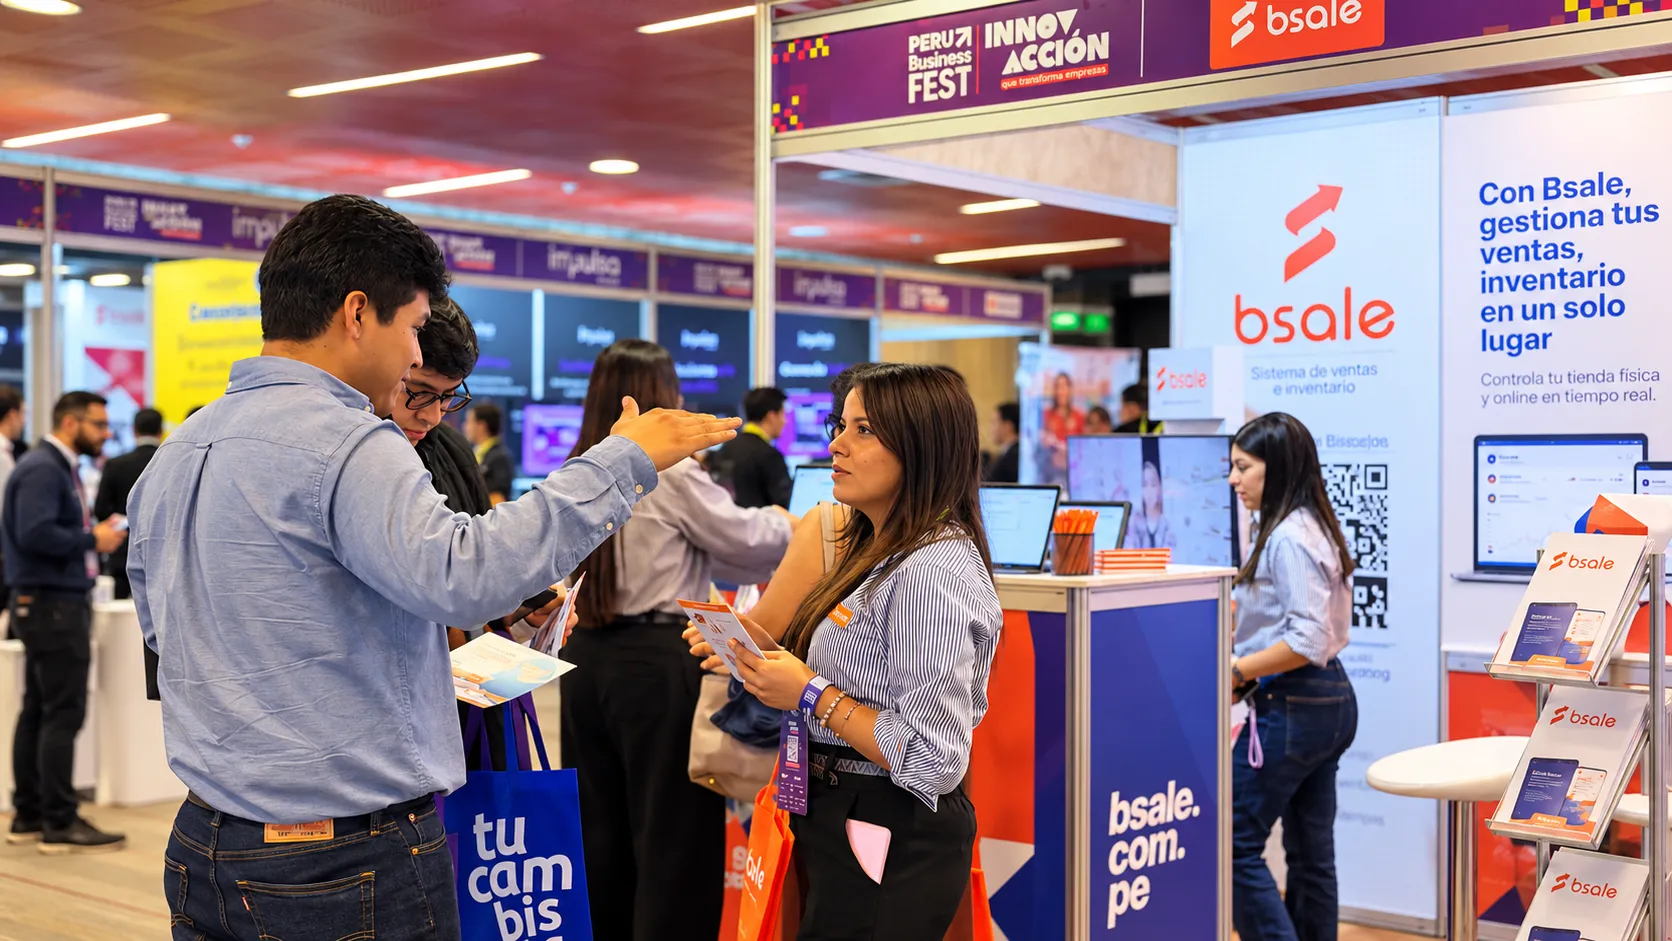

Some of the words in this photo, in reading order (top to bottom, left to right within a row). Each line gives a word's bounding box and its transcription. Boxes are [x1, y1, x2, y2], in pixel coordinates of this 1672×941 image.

[1267, 0, 1362, 36] bsale
[908, 29, 954, 54] PERU
[1001, 28, 1110, 75] ACCIÓN
[908, 50, 972, 72] Business
[908, 65, 972, 104] FEST
[1001, 80, 1017, 90] que
[1019, 73, 1063, 86] transforma
[1065, 66, 1107, 80] empresas
[1479, 182, 1534, 206] Con
[1543, 171, 1631, 201] Bsale,
[1479, 206, 1604, 242] gestiona
[1611, 202, 1659, 225] tus
[1480, 239, 1583, 265] ventas,
[1481, 262, 1625, 294] inventario
[1234, 286, 1395, 345] bsale
[1481, 304, 1513, 323] en
[1521, 302, 1556, 321] un
[1563, 293, 1625, 319] solo
[1481, 329, 1552, 357] lugar
[1251, 366, 1306, 380] Sistema
[1309, 364, 1328, 379] de
[1330, 364, 1378, 377] ventas
[1273, 384, 1282, 396] e
[1285, 379, 1356, 395] inventario
[1481, 371, 1544, 387] Controla
[1548, 372, 1563, 385] tu
[1567, 369, 1615, 384] tienda
[1619, 367, 1660, 382] física
[1481, 394, 1490, 408] y
[1493, 391, 1538, 405] online
[1542, 391, 1561, 404] en
[1565, 389, 1619, 405] tiempo
[1623, 387, 1656, 402] real.
[1568, 555, 1614, 570] bsale
[1570, 710, 1616, 728] bsale
[1109, 780, 1200, 836] bsale.
[473, 813, 527, 861] tu
[1108, 828, 1186, 876] com.
[468, 854, 573, 903] cam
[1571, 877, 1617, 899] bsale
[493, 895, 562, 941] bis
[1107, 875, 1151, 930] pe
